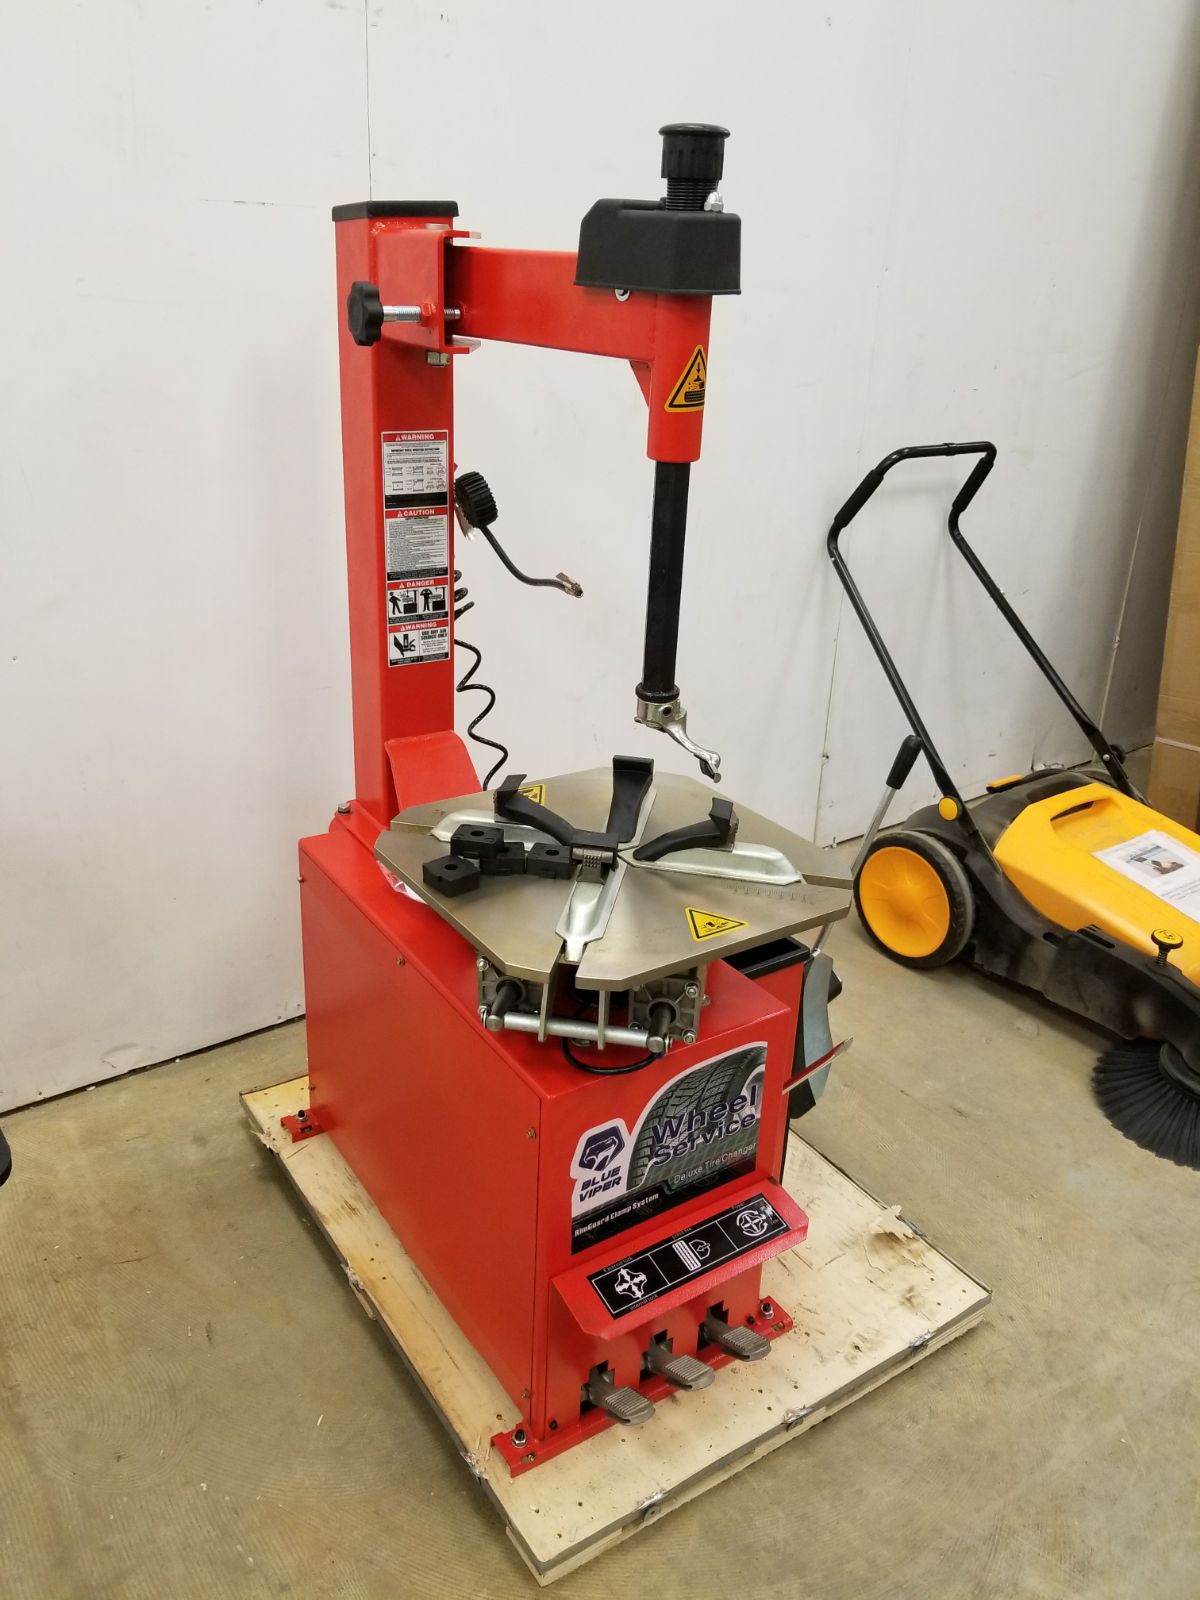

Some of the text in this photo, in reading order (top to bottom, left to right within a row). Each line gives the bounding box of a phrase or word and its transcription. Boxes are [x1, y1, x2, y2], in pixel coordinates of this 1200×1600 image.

[401, 433, 435, 441] WARNING
[403, 509, 435, 517] CAUTION
[406, 579, 435, 588] DANGER
[405, 621, 437, 630] WARNING
[651, 1084, 758, 1145] Wheel
[652, 1113, 757, 1166] Service
[673, 1142, 757, 1184] Deluxe Tire Changer
[579, 1176, 622, 1202] VIPER
[581, 1165, 622, 1192] BLUE
[574, 1193, 659, 1237] RimGuard Clamp System
